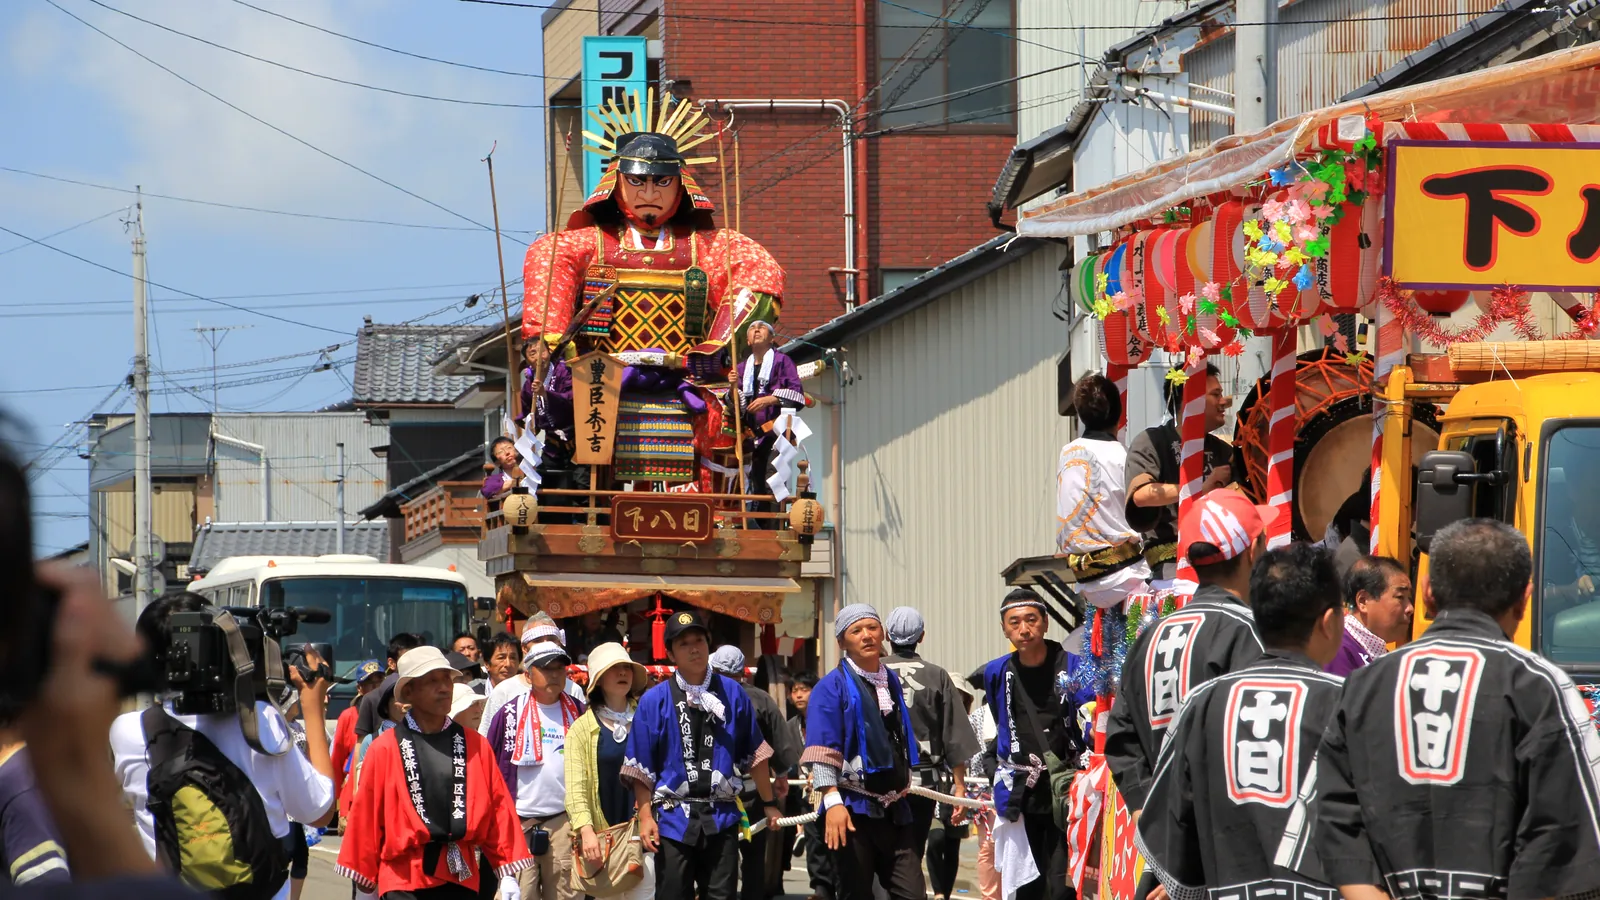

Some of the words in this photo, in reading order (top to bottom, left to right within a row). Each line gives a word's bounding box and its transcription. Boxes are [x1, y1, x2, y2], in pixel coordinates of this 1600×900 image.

[584, 358, 607, 453] 豊臣秀吉
[624, 506, 700, 532] 下八日
[1153, 625, 1188, 716] 十日
[452, 733, 466, 778] 金津地区
[1236, 690, 1288, 792] 十日
[452, 783, 466, 820] 区長会
